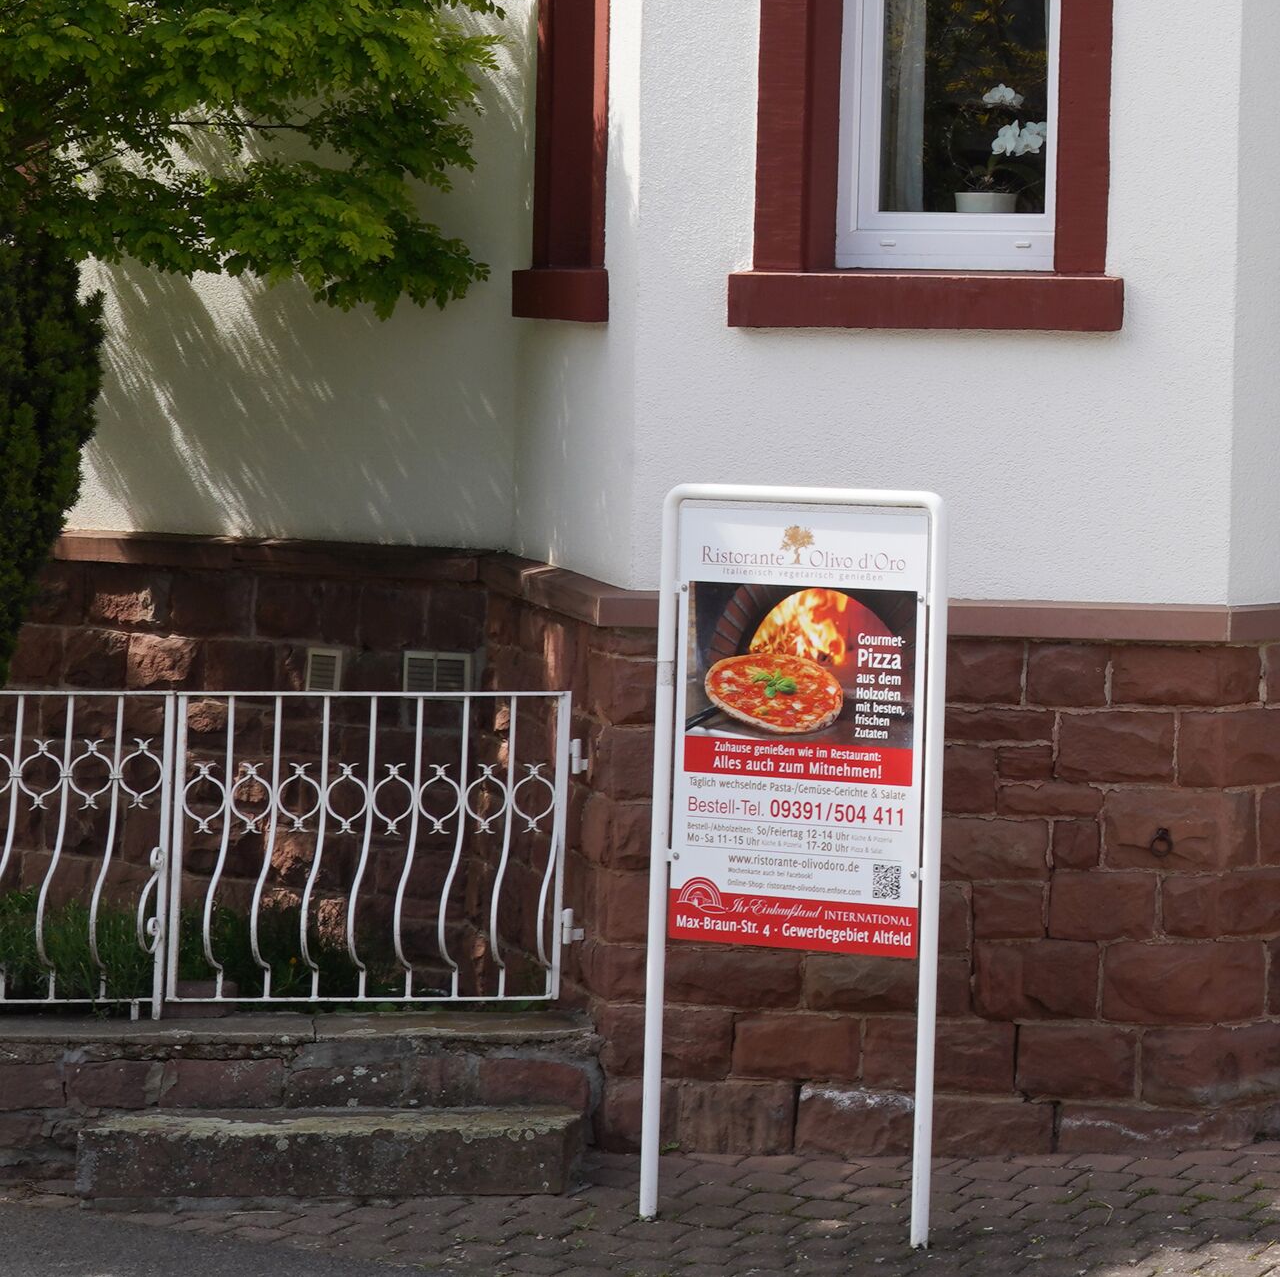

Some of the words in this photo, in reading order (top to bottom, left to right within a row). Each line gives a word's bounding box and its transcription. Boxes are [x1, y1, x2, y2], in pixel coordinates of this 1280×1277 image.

[701, 545, 785, 566] Ristorante
[809, 549, 853, 569] Olivo
[858, 552, 907, 571] d'Oro
[722, 567, 774, 578] Italienisch
[779, 569, 834, 581] vegetarisch
[839, 573, 884, 582] genießen
[857, 632, 906, 647] Gourmet-
[857, 648, 902, 670] Pizza
[856, 673, 876, 684] aus
[878, 672, 902, 686] dem
[855, 687, 901, 701] Holzofen
[855, 701, 871, 712] mit
[873, 702, 905, 716] besten,
[854, 713, 890, 726] frischen
[854, 727, 889, 740] Zutaten
[714, 741, 752, 754] Zuhause
[754, 744, 795, 756] genießen
[797, 746, 814, 758] wie
[816, 746, 828, 759] im
[830, 748, 882, 762] Restaurant:
[713, 755, 742, 770] Alles
[745, 757, 775, 772] auch
[778, 761, 804, 774] zum
[809, 762, 882, 779] Mitnehmen!
[689, 776, 716, 789] Täglich
[718, 778, 767, 792] wechselnde
[769, 782, 868, 798] Pasta-/Gemüse-Gerichte
[871, 788, 878, 799] &
[880, 789, 906, 801] Salate
[687, 796, 765, 817] Bestell-Tel.
[769, 799, 867, 823] 09391/504
[873, 806, 905, 826] 411
[687, 832, 714, 843] Mo-Sa
[717, 834, 744, 845] 11-15
[746, 836, 760, 846] Uhr
[806, 841, 833, 852] 17-20
[835, 843, 849, 853] Uhr
[756, 825, 803, 840] So/Feiertag
[806, 829, 833, 840] 12-14
[835, 831, 850, 841] Uhr
[728, 854, 860, 873] www.ristorante-olivodoro.de
[727, 878, 766, 889] Online-Shop:
[726, 897, 749, 914] Ihr
[824, 910, 912, 927] INTERNATIONAL
[676, 914, 759, 935] Max-Braun-Str.
[763, 924, 771, 937] 4
[782, 923, 869, 943] Gewerbegebiet
[873, 930, 911, 947] Altfeld
